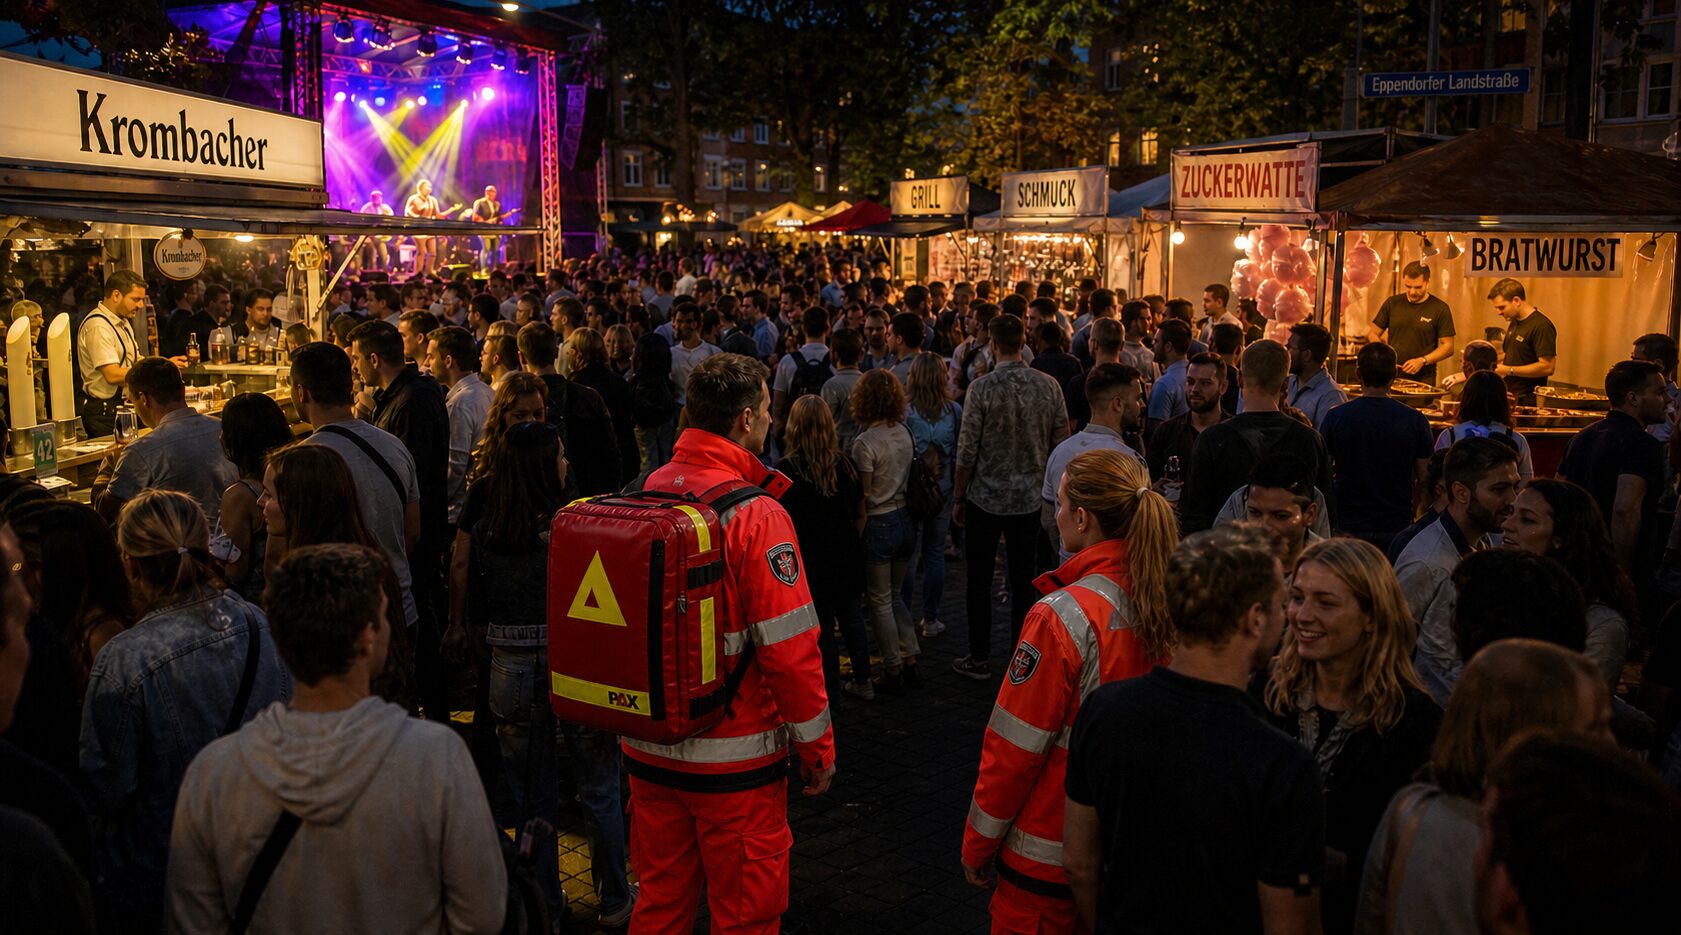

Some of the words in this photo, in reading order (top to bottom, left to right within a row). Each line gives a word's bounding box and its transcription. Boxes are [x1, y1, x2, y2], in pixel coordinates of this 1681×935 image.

[1372, 76, 1445, 94] Eppendorfer
[1449, 72, 1519, 90] Landstraße
[77, 89, 268, 171] Krombacher
[1181, 160, 1306, 198] ZUCKERWATTE
[911, 184, 940, 209] GRILL
[1018, 179, 1076, 208] SCHMUCK
[1472, 238, 1621, 271] BRATWURST
[37, 438, 53, 463] 42
[607, 690, 640, 710] PAX
